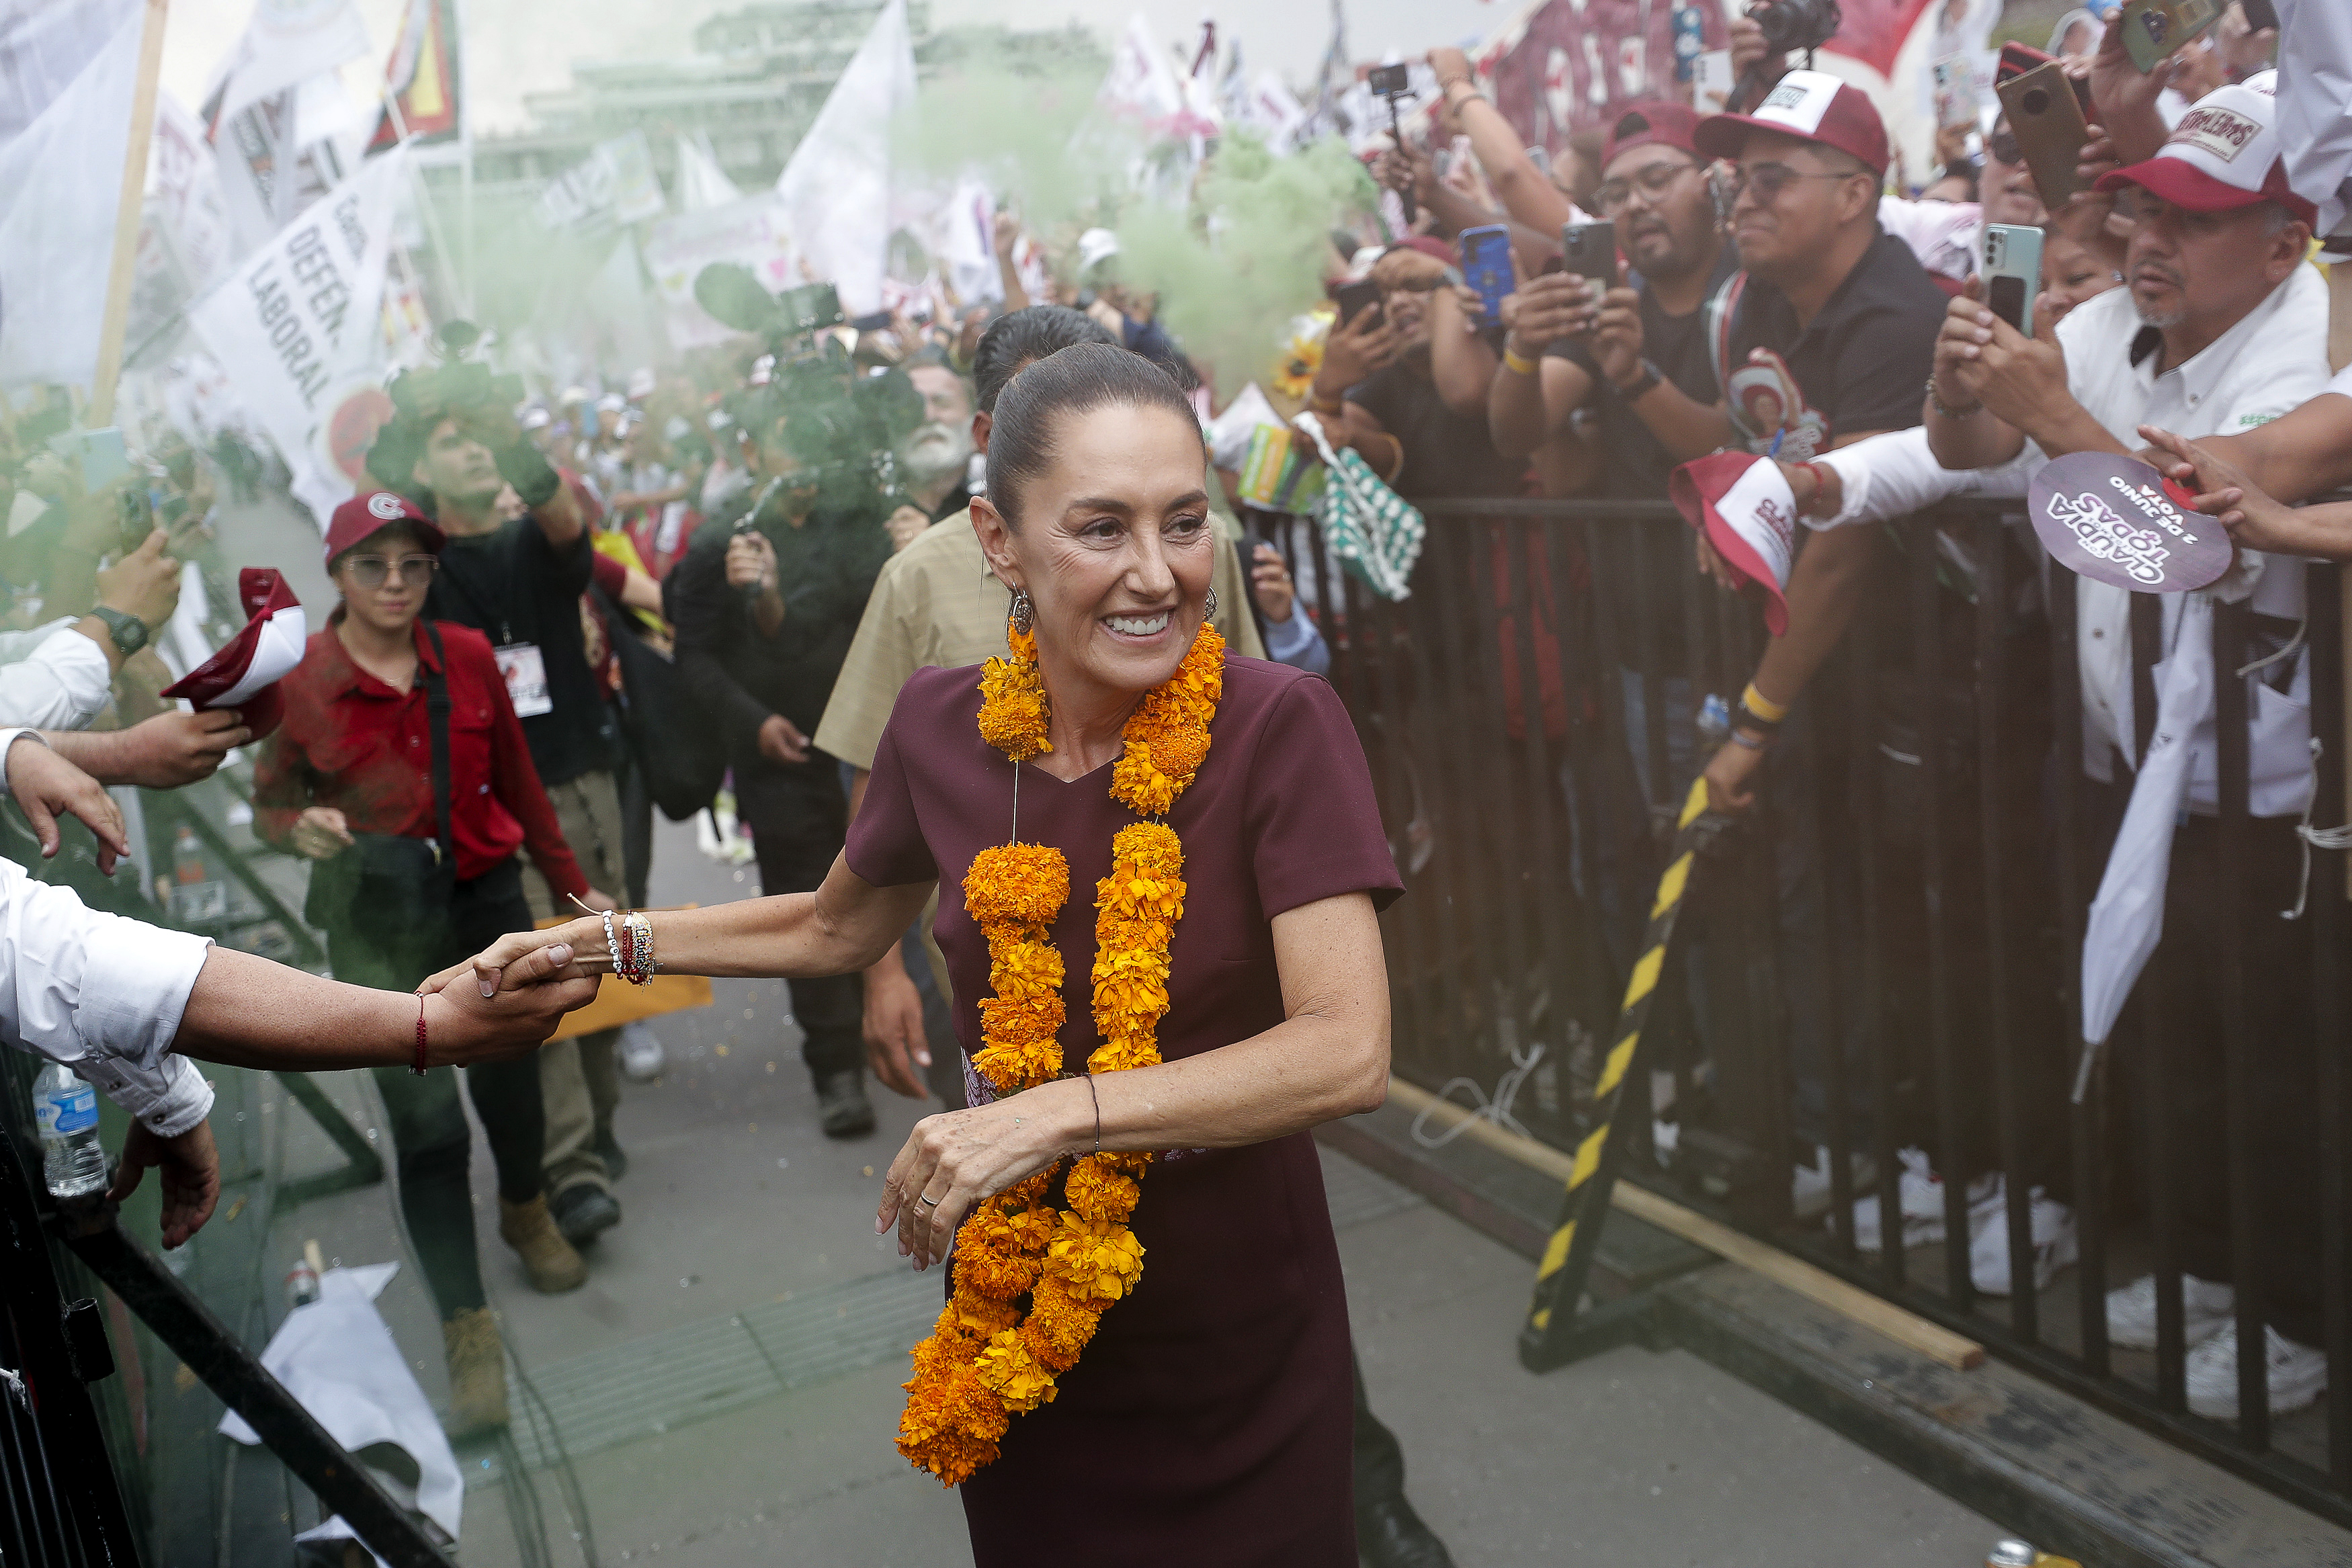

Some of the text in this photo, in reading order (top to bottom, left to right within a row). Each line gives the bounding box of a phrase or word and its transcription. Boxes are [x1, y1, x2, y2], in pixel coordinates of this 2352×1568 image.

[284, 222, 351, 349] DEFEN
[247, 257, 330, 412] LABORAL
[2048, 494, 2162, 582] CLAUDIA
[2076, 494, 2168, 568] TODAS
[2109, 476, 2199, 545] 2 DE JUNIO
[2138, 484, 2185, 525] VOTA
[2083, 541, 2104, 557] CON
